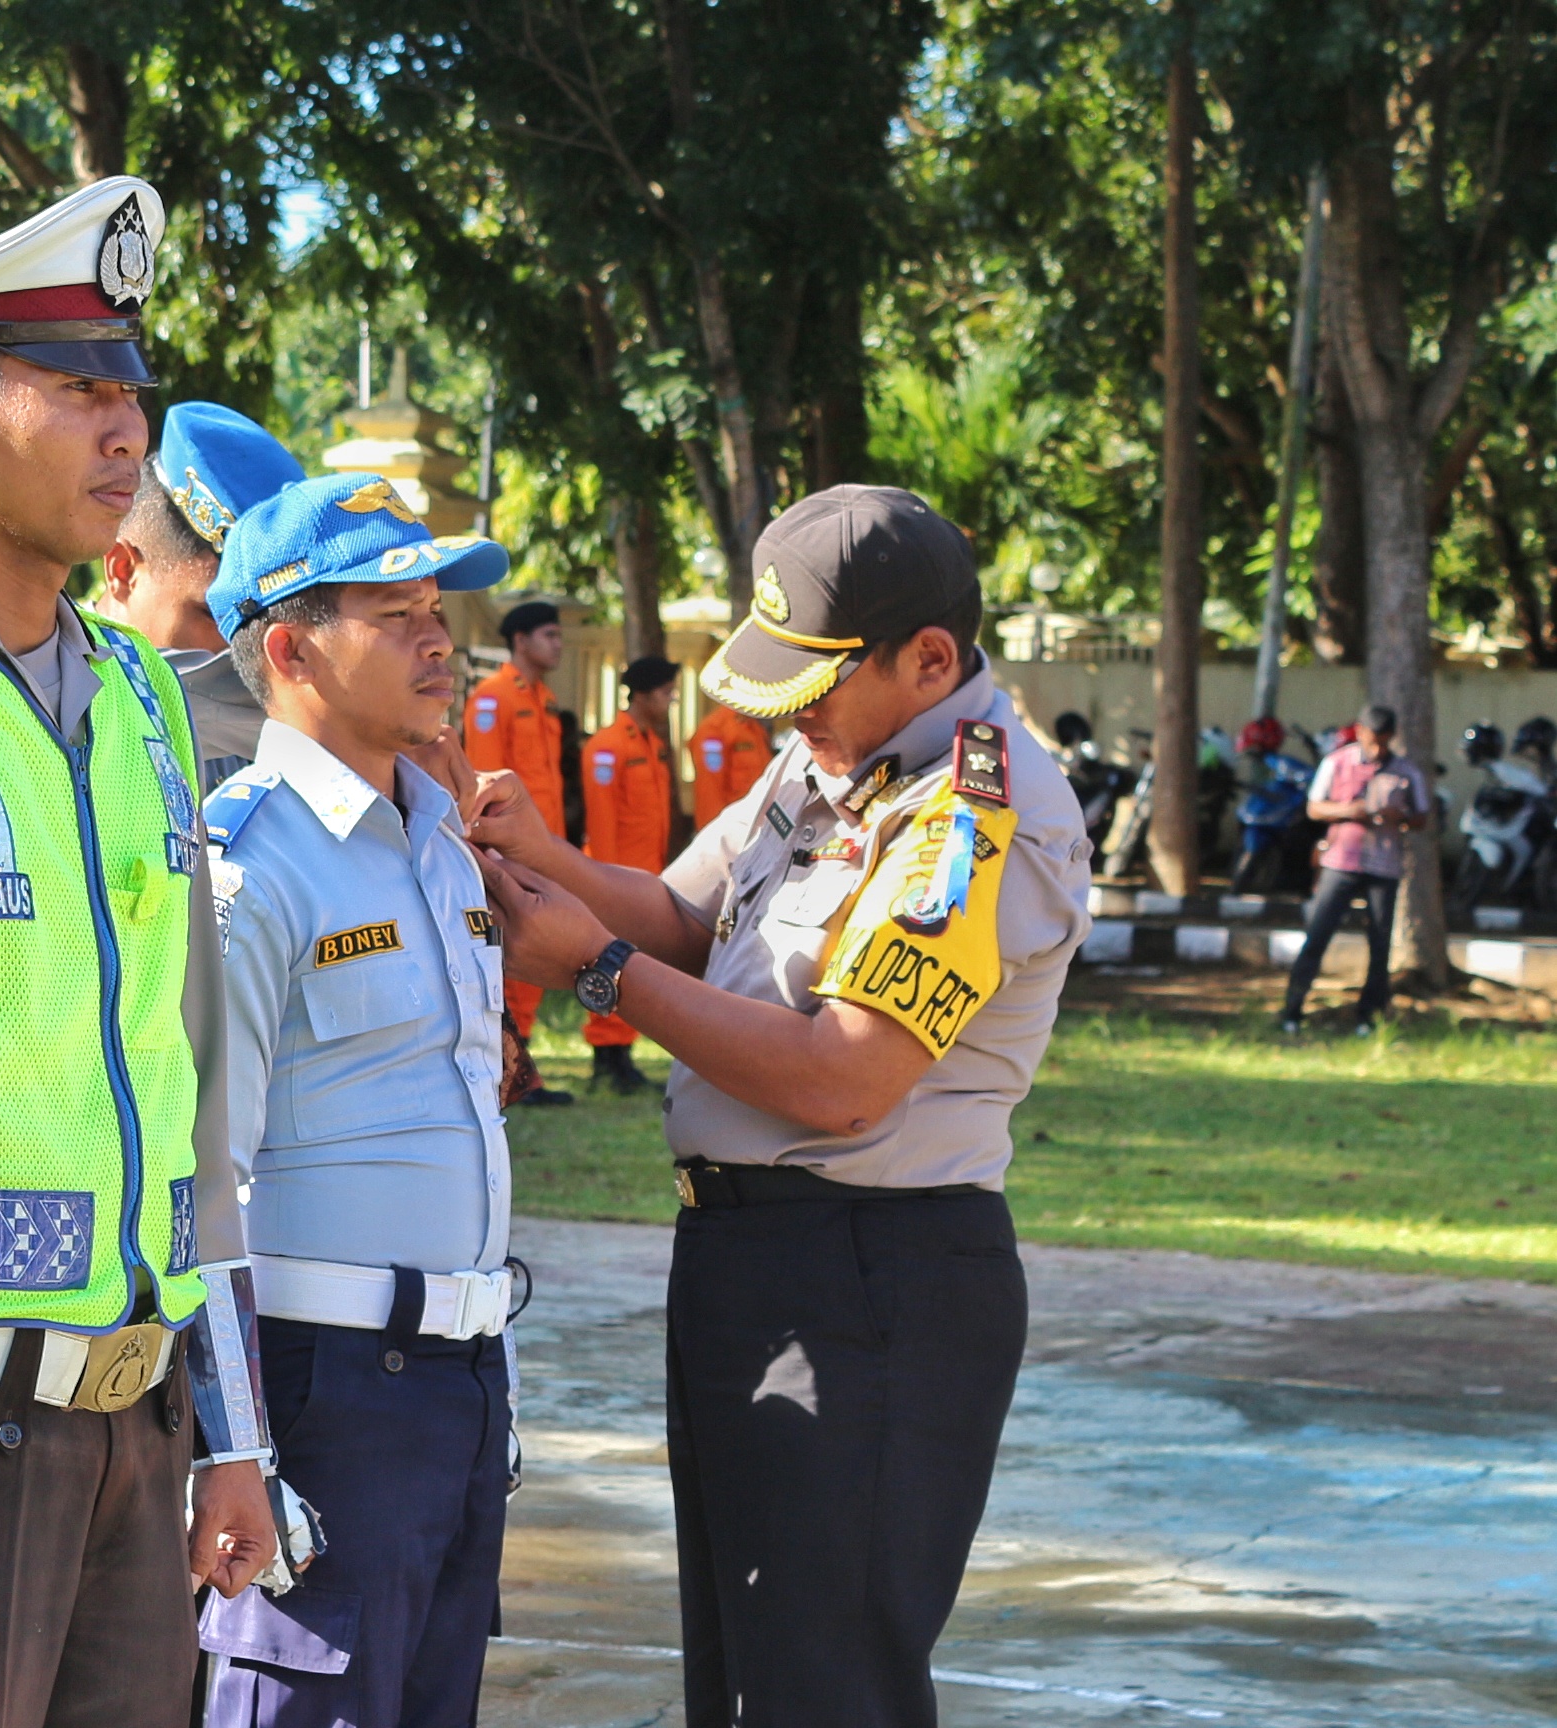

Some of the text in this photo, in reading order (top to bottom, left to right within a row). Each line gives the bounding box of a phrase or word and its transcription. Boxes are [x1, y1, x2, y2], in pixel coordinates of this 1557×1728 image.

[258, 559, 312, 595] BONEY
[324, 926, 394, 961] BONEY
[863, 938, 939, 1013] OPS
[915, 969, 980, 1049] RES
